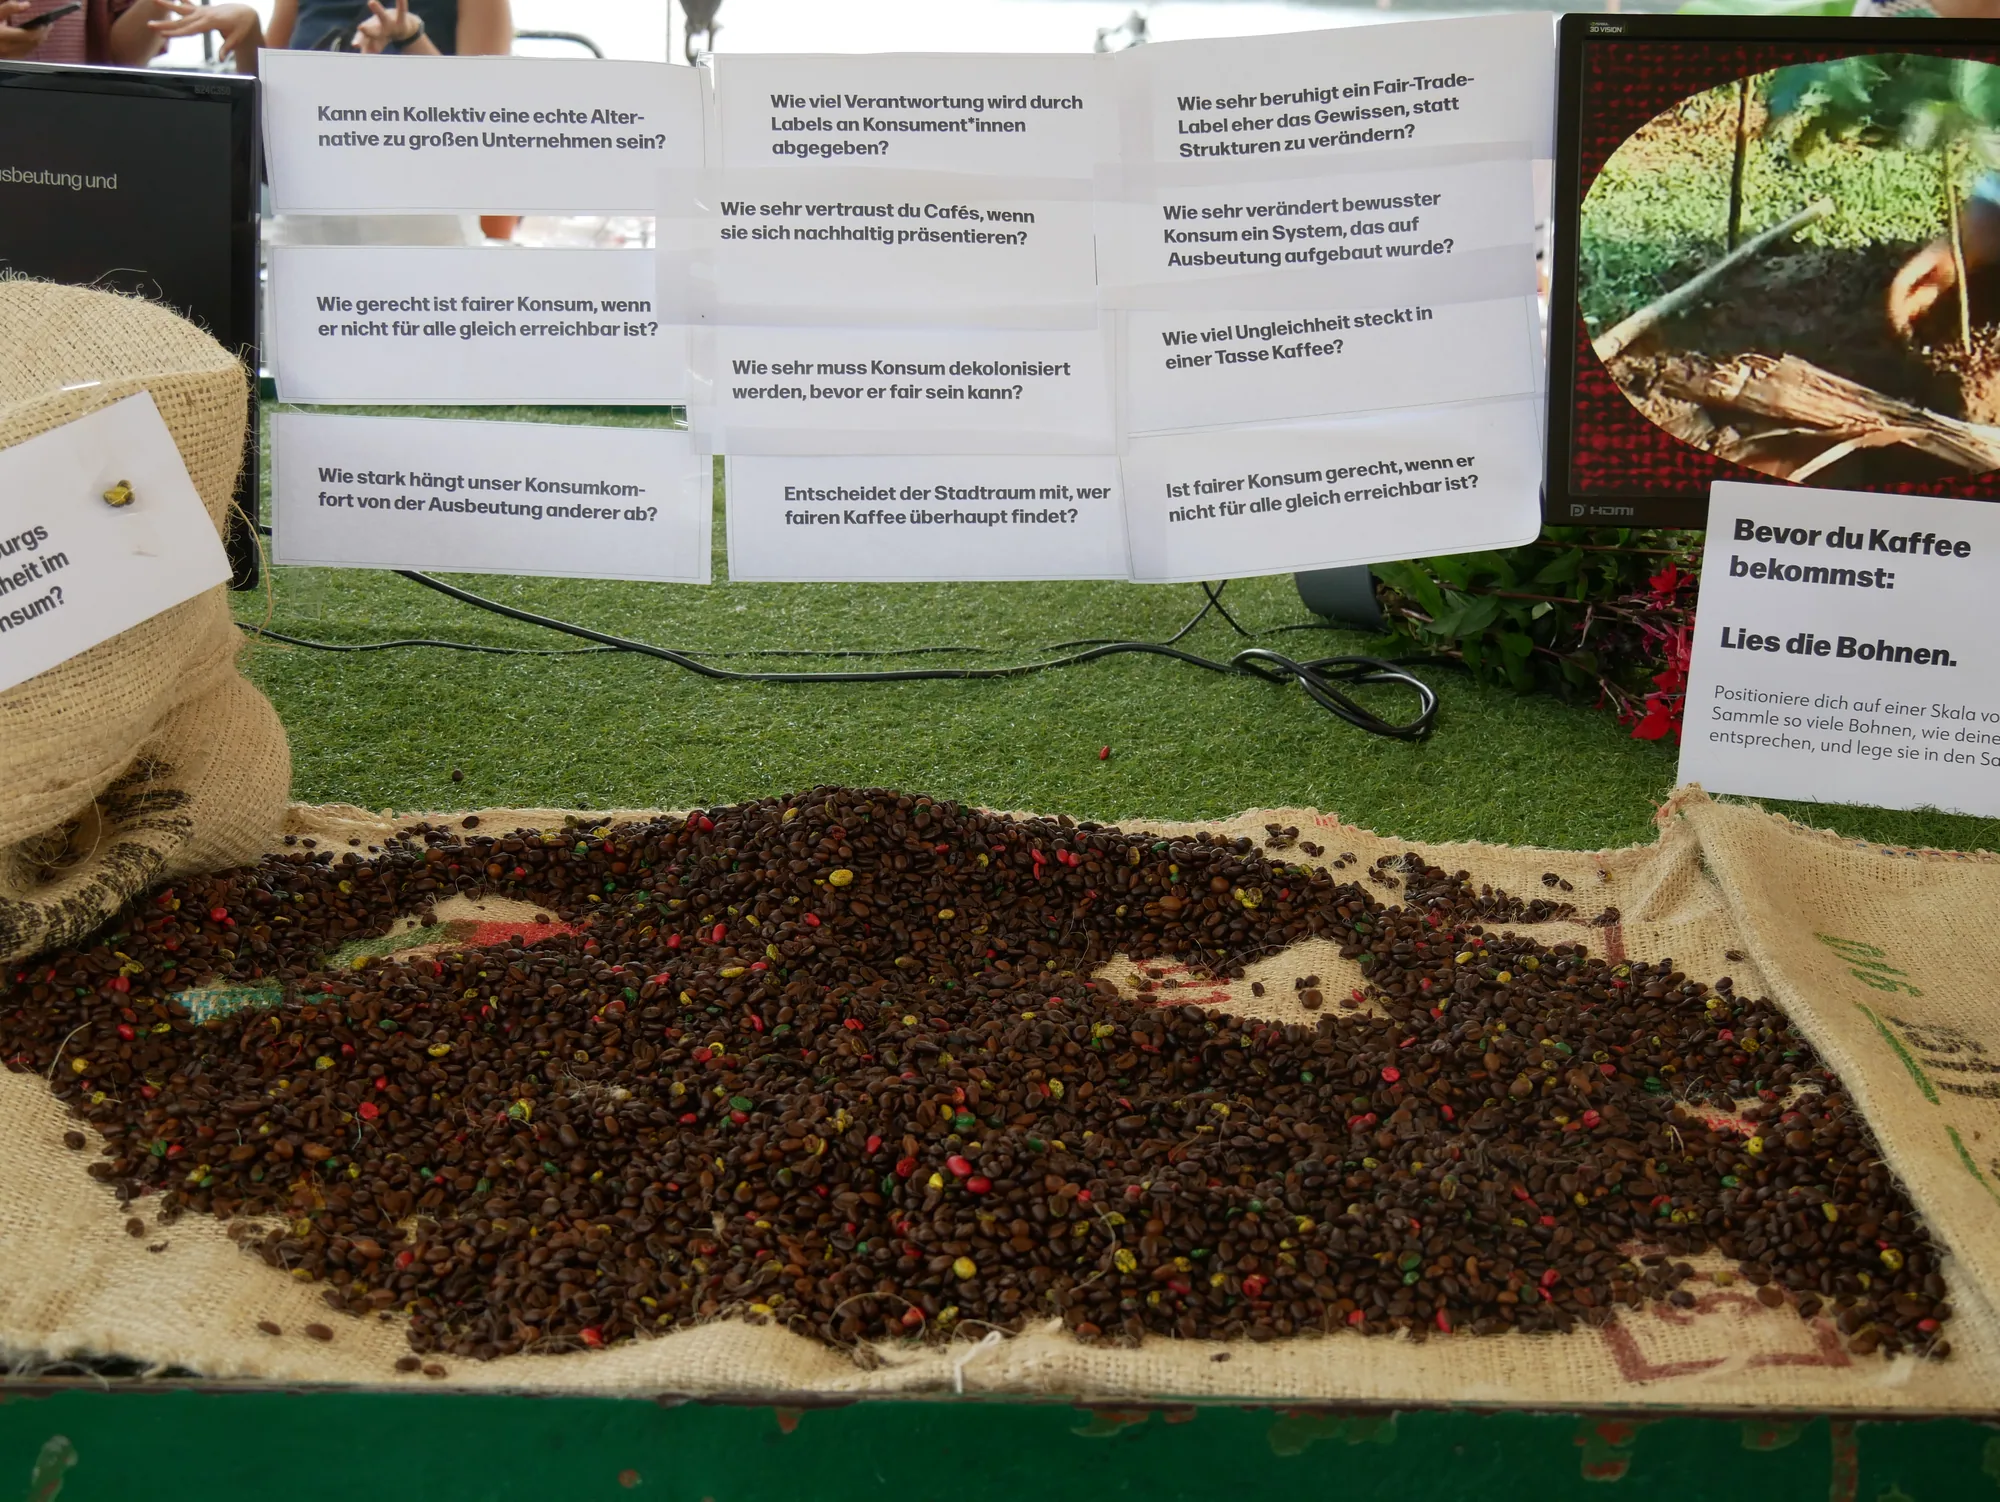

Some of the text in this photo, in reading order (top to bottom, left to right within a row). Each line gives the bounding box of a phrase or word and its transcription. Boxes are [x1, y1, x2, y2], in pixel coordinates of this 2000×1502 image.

[770, 94, 1083, 113] Wie viel Verantwortung wird durch
[1176, 72, 1475, 111] Wie sehr beruhigt ein Fair-Trade-
[317, 105, 645, 125] Kann ein Kollektiv eine echte Alter-
[771, 116, 833, 132] Labels
[836, 120, 860, 132] an
[1178, 97, 1460, 135] Label eher das Gewissen, statt
[318, 130, 666, 151] native zu großen Unternehmen sein?
[772, 139, 889, 159] abgegeben?
[1179, 123, 1416, 158] Strukturen zu verändern?
[86, 173, 118, 190] und
[720, 201, 1035, 224] Wie sehr vertraust du Cafés, wenn
[1162, 192, 1442, 221] Wie sehr verändert bewusster
[720, 224, 1028, 246] sie sich nachhaltig präsentieren?
[1163, 215, 1420, 244] Konsum ein System, das auf
[1167, 238, 1454, 268] Ausbeutung aufgebaut wurde?
[316, 296, 651, 316] Wie gerecht ist fairer Konsum, wenn
[318, 320, 659, 341] er nicht für alle gleich erreichbar ist?
[1161, 305, 1433, 347] Wie viel Ungleichheit steckt in
[732, 359, 1071, 377] Wie sehr muss Konsum dekolonisiert
[1165, 338, 1344, 370] einer Tasse Kaffee?
[732, 383, 1023, 402] werden, bevor er fair sein kann?
[317, 467, 646, 497] Wie stark hängt unser Konsumkom-
[1166, 456, 1476, 499] Ist fairer Konsum gerecht, wenn er
[317, 491, 658, 522] fort von der Ausbeutung anderer ab?
[784, 484, 1112, 502] Entscheidet der Stadtraum mit, wer
[1168, 474, 1479, 523] nicht für alle gleich erreichbar ist?
[784, 508, 1079, 527] fairen Kaffee überhaupt findet?
[1589, 506, 1634, 516] HDMI
[1733, 518, 1972, 559] Bevor du Kaffee
[39, 551, 70, 575] im
[1729, 554, 1895, 590] bekommst:
[1720, 626, 1957, 667] Lies die Bohnen.
[1714, 684, 1810, 707] Positioniere
[1814, 693, 1849, 710] dich
[1853, 697, 1882, 713] auf
[1884, 701, 1927, 717] einer
[1930, 703, 1976, 721] Skala
[1711, 705, 1780, 726] Sammle
[1783, 716, 1802, 728] so
[1806, 715, 1844, 732] viele
[1848, 718, 1916, 741] Bohnen,
[1921, 726, 1950, 741] wie
[1709, 730, 1816, 753] entsprechen,
[1820, 738, 1853, 754] und
[1856, 739, 1893, 761] lege
[1896, 745, 1920, 760] sie
[1924, 747, 1939, 762] in
[1943, 748, 1975, 765] den
